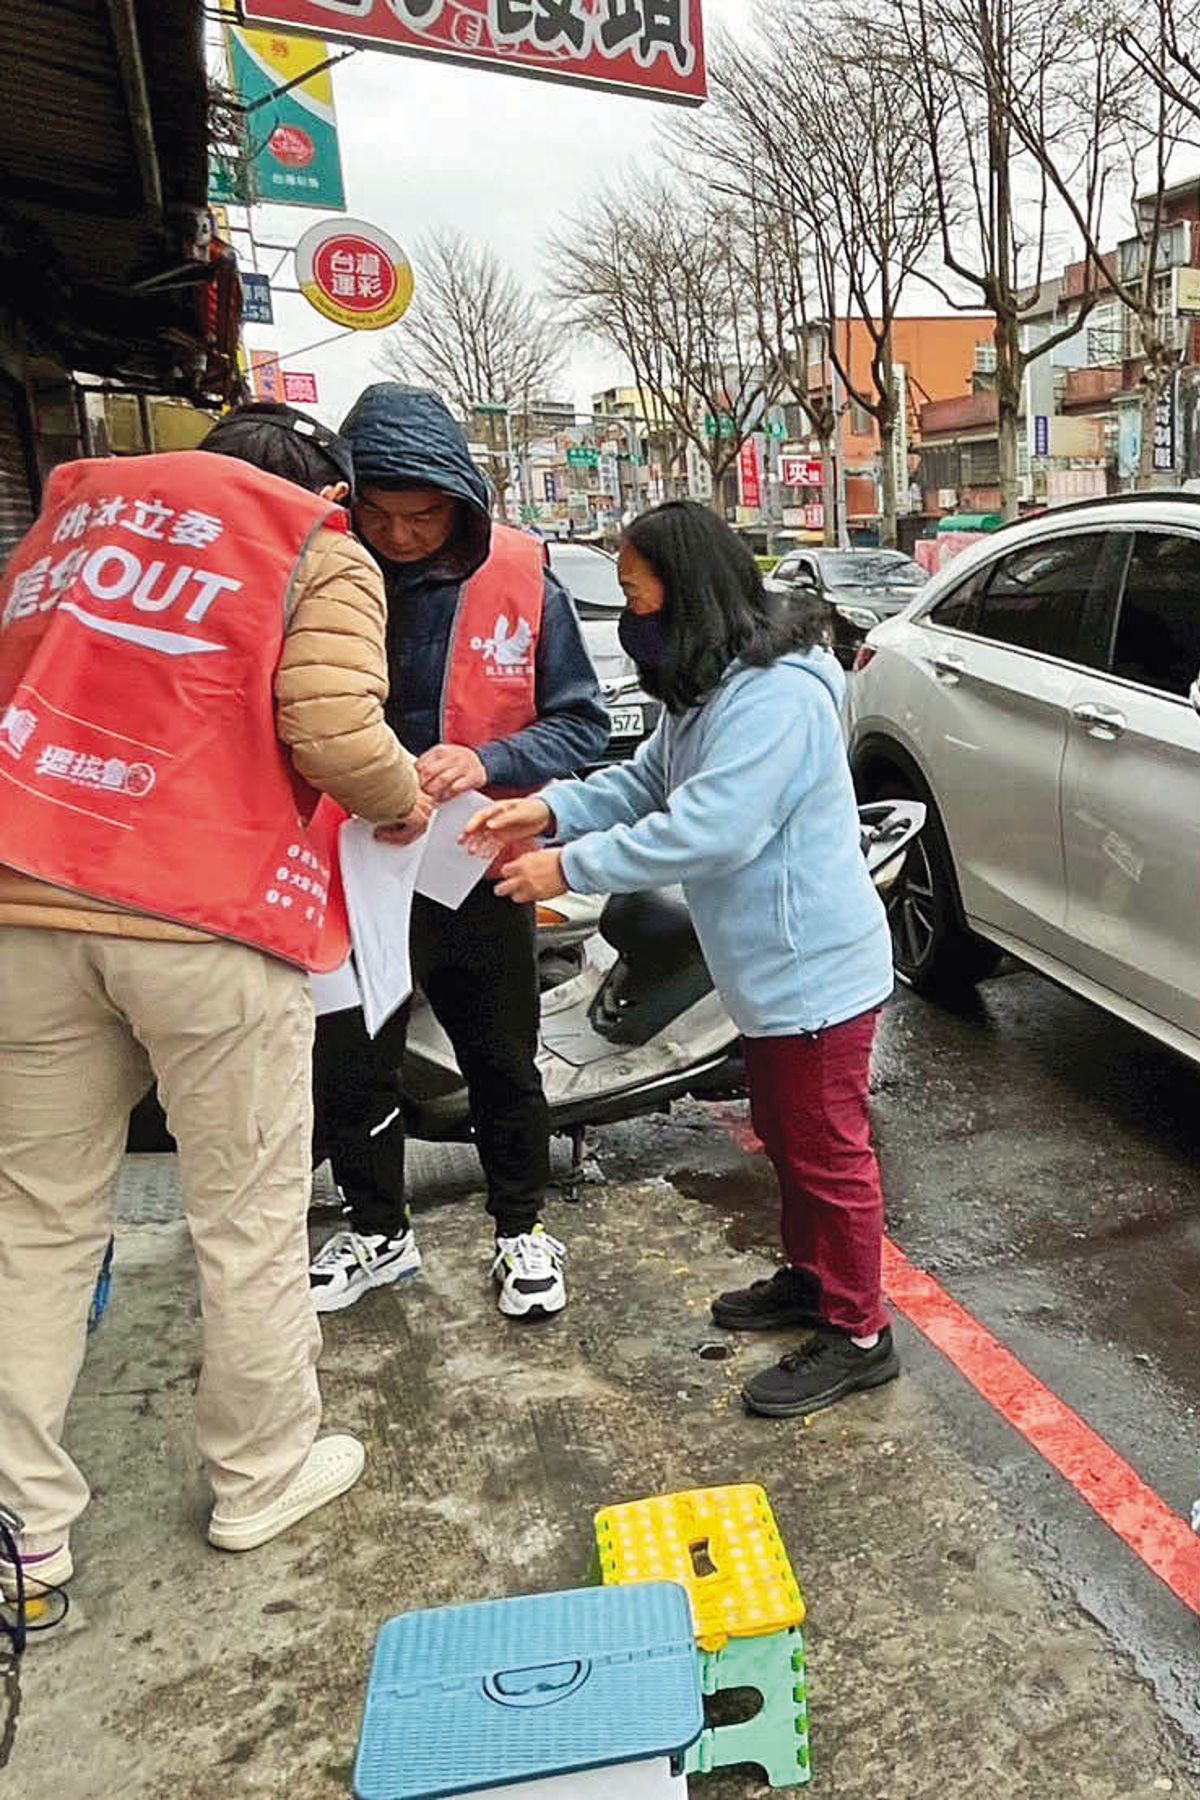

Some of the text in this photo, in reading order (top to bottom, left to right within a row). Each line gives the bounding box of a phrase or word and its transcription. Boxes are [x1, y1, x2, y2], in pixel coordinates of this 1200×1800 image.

[330, 250, 381, 276] 台灣
[331, 272, 383, 298] 運彩
[613, 713, 641, 732] 572
